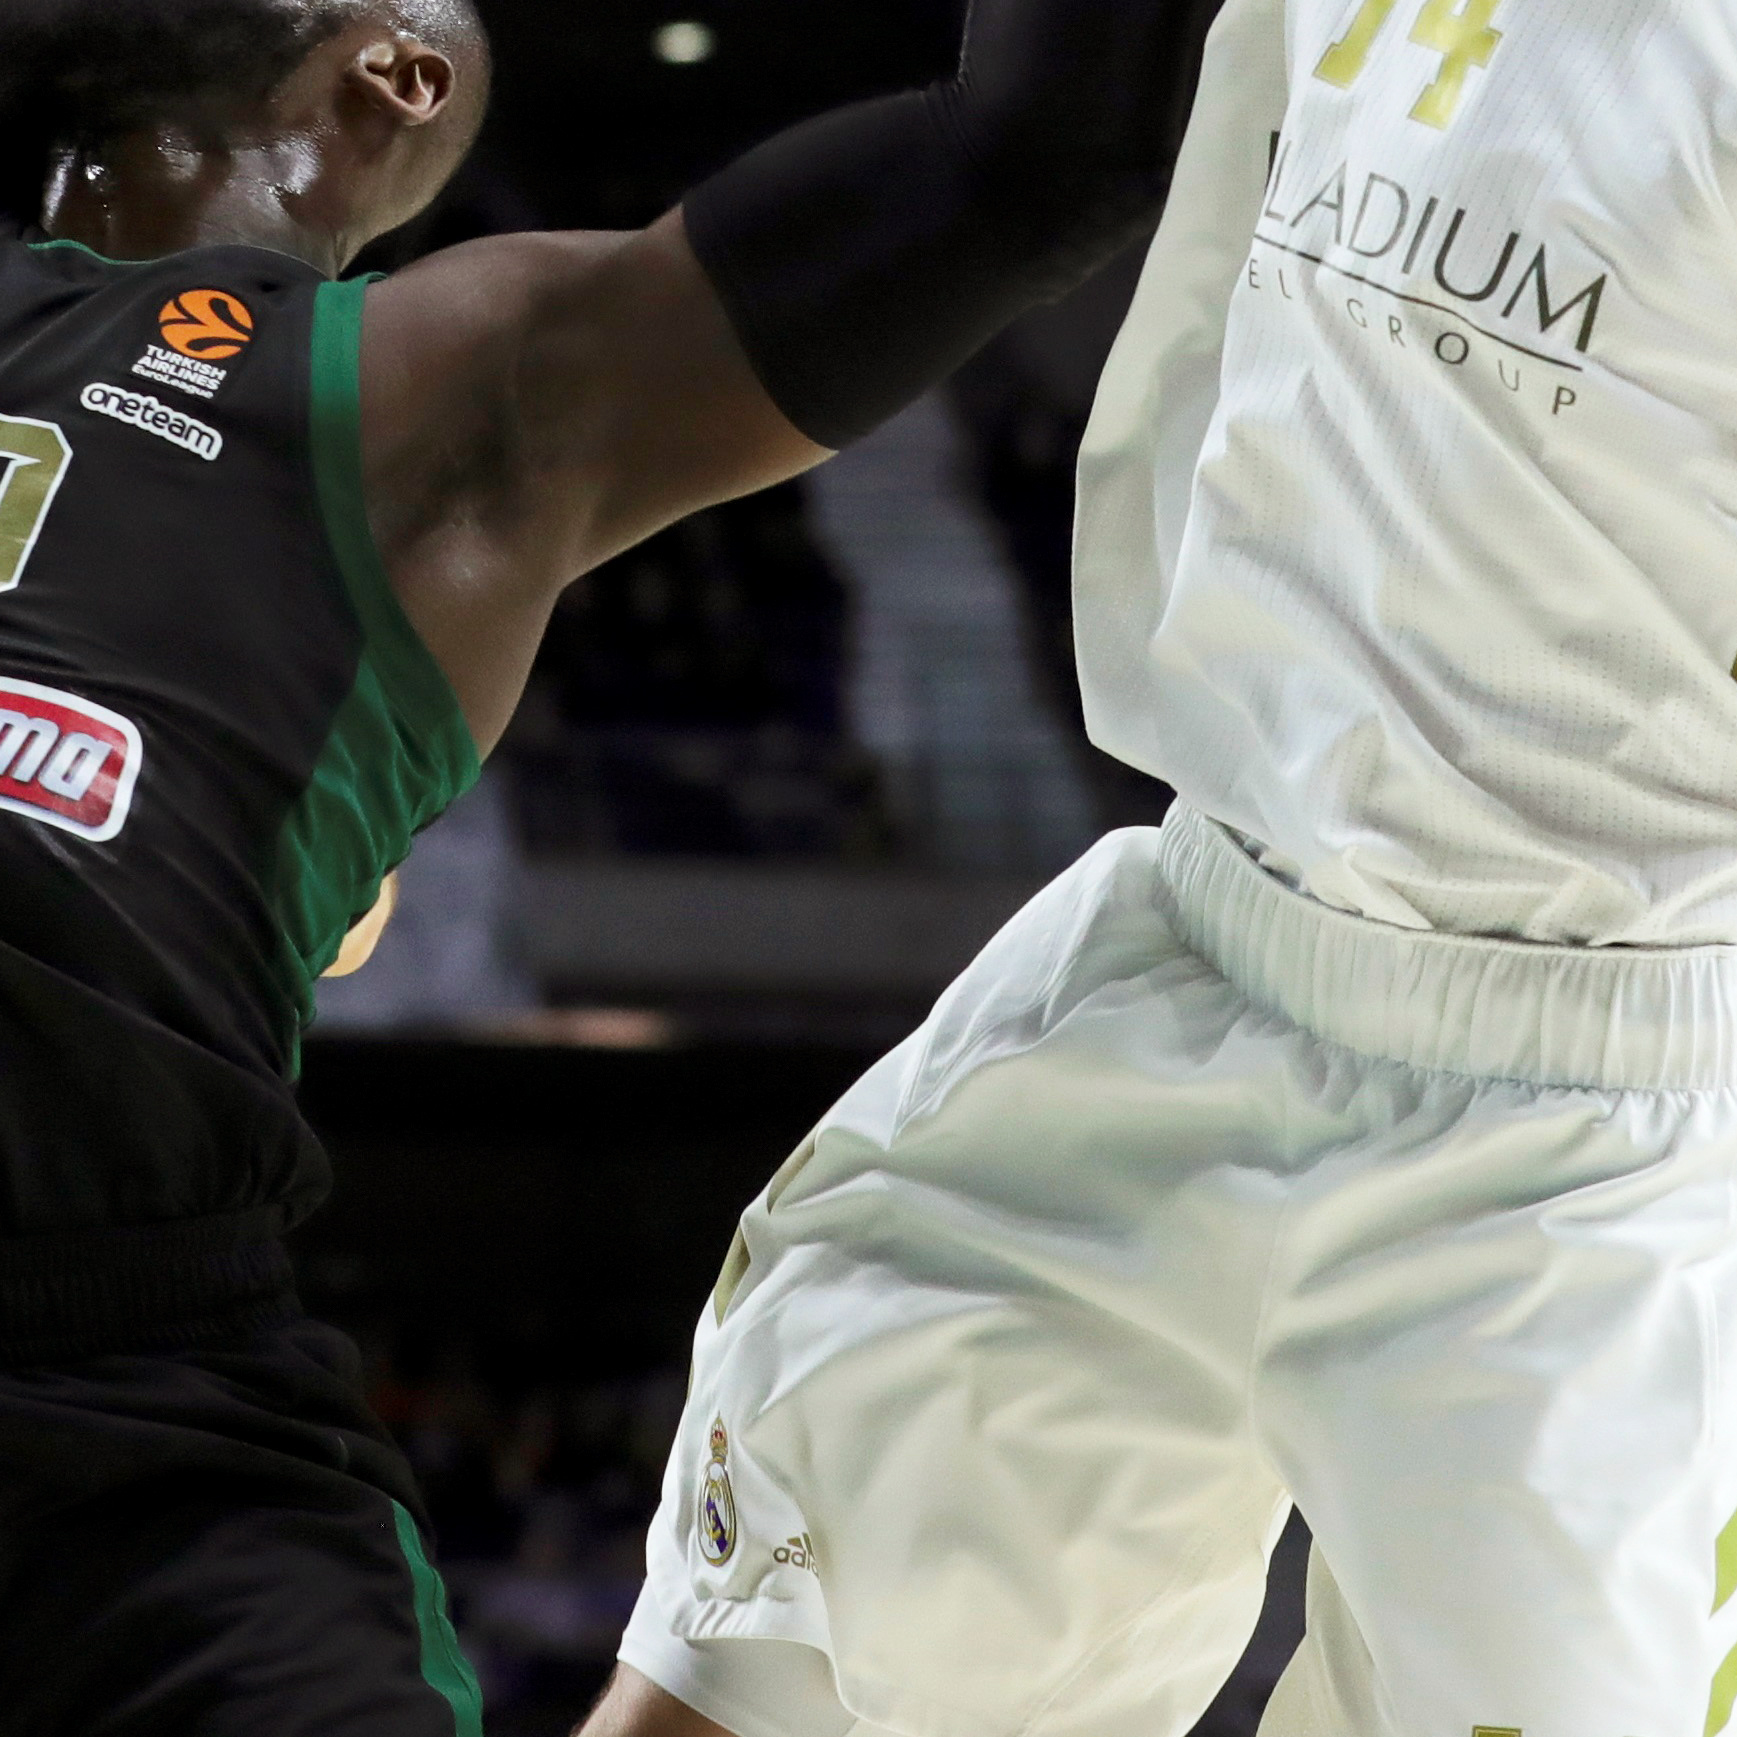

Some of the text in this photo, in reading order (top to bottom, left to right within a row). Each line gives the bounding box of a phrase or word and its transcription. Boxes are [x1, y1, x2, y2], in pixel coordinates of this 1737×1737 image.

[137, 355, 222, 391] AIRLINES
[146, 343, 228, 381] TURKISH
[1346, 297, 1577, 415] GROUP
[87, 387, 217, 455] oneteam
